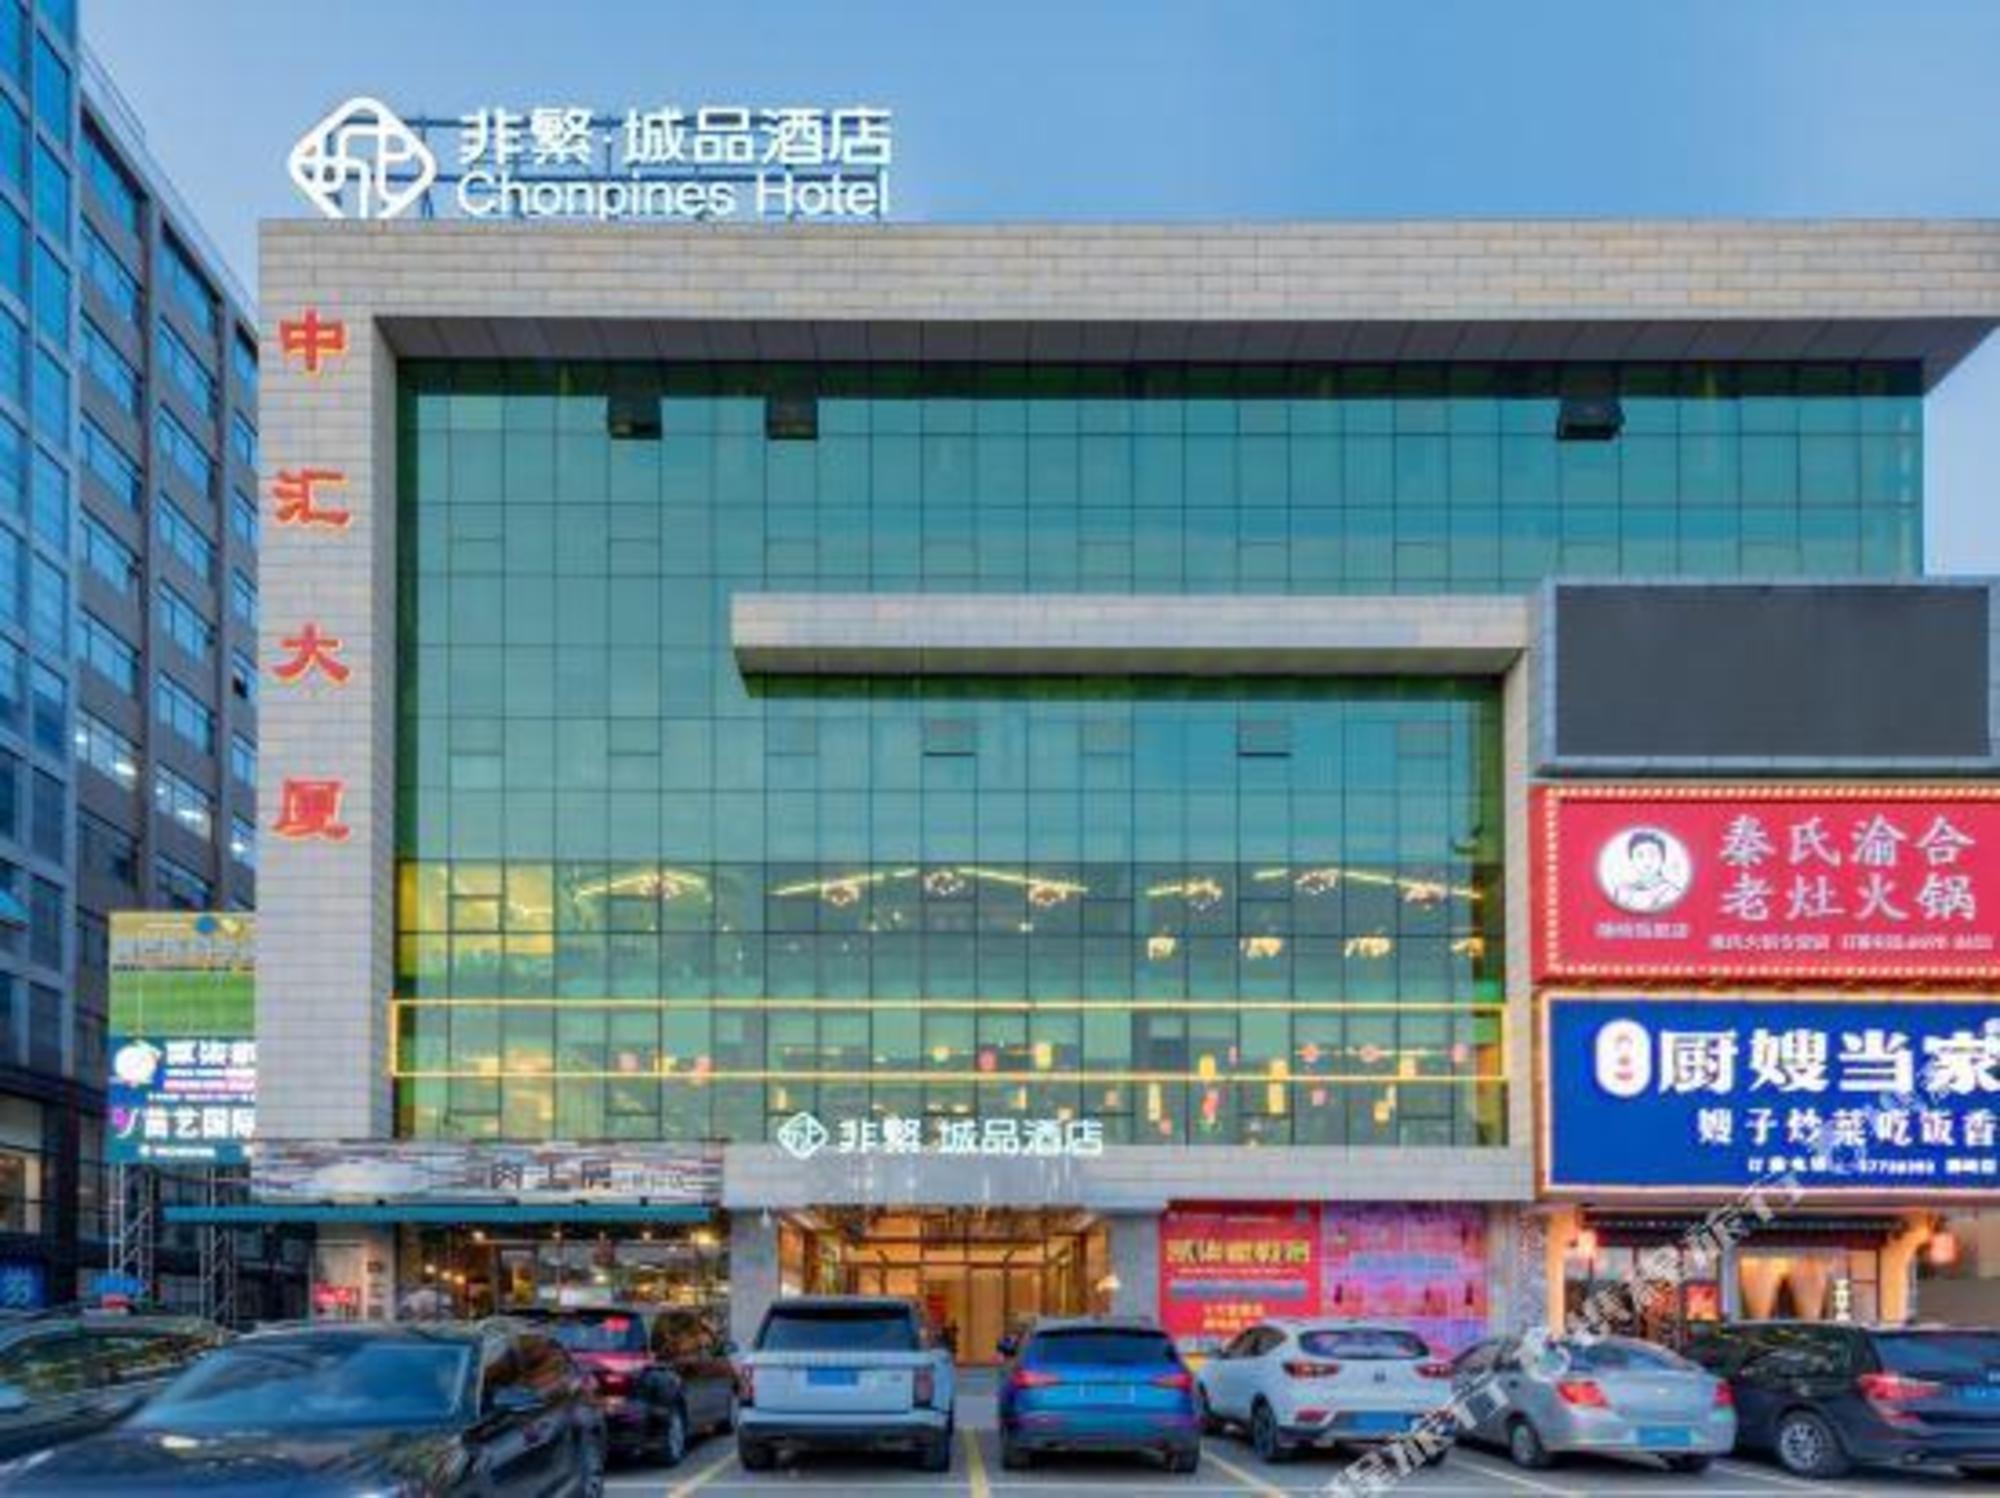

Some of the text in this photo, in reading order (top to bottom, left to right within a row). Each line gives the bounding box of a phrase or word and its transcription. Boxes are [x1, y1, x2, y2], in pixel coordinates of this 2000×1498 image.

[456, 169, 890, 217] Chonpines Hotel
[272, 309, 350, 840] 中汇大厦
[1719, 872, 1977, 922] 老灶火锅
[1658, 1028, 2000, 1095] 厨嫂当家
[1698, 1107, 1998, 1147] 嫂子炒菜吃饭香
